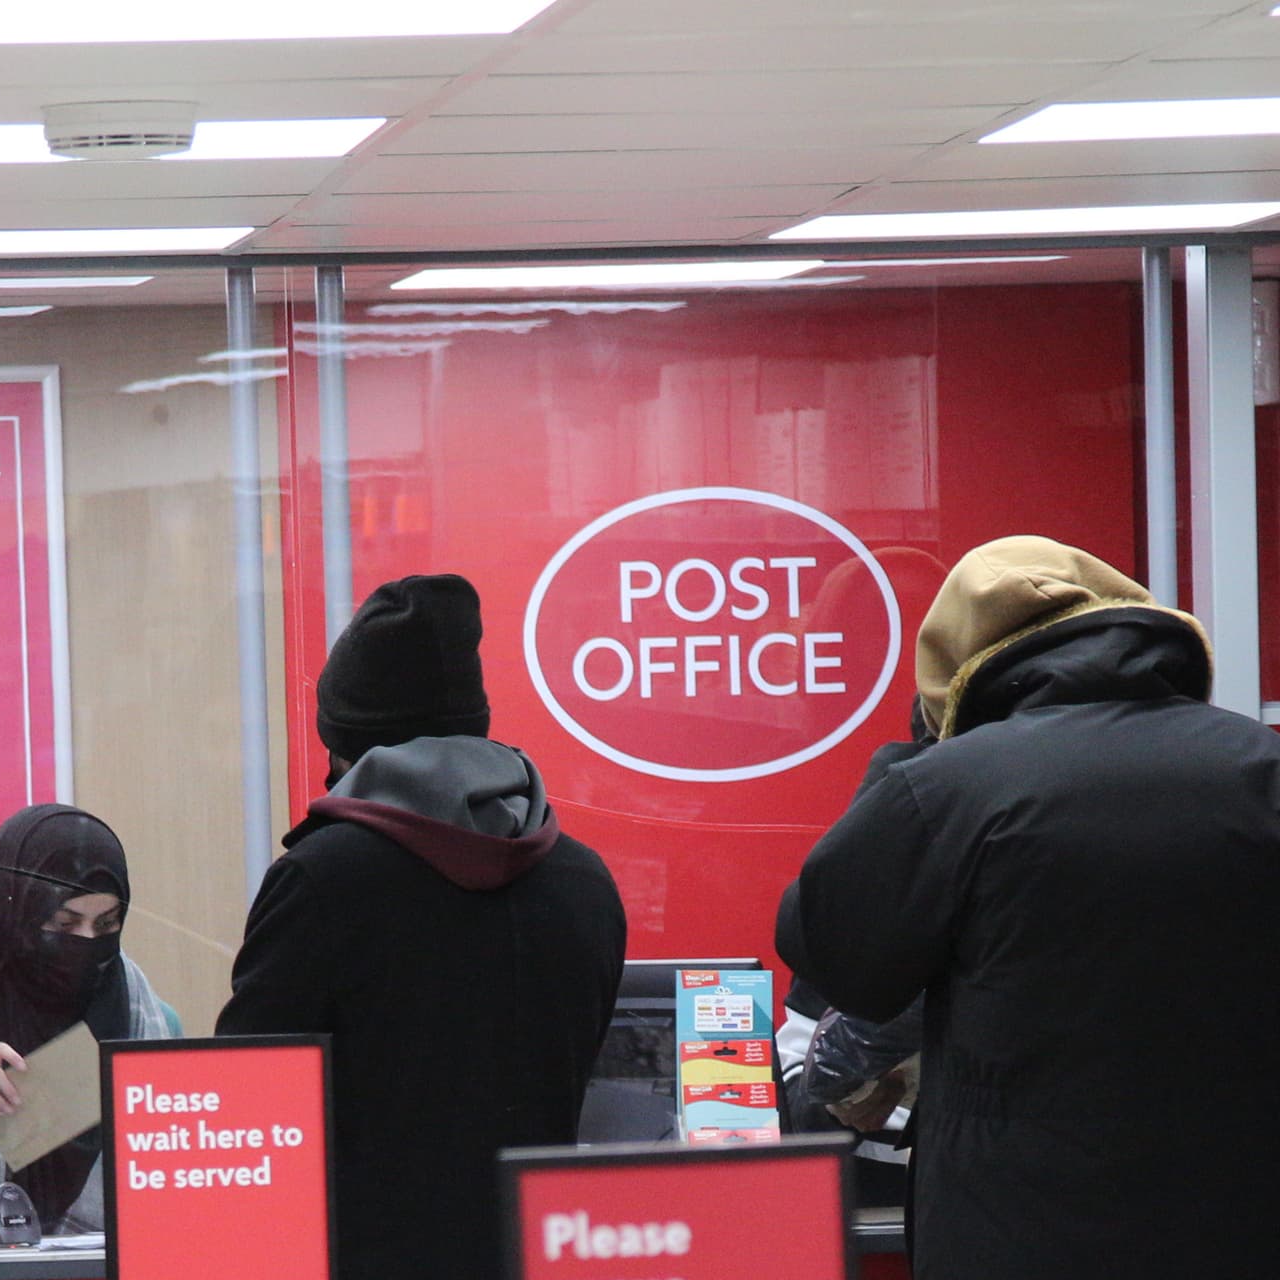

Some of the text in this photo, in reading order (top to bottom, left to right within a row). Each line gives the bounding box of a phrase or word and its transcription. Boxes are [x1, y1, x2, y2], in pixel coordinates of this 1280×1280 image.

[620, 557, 816, 623] POST
[572, 632, 846, 701] OFFICE
[125, 1084, 220, 1114] Please
[127, 1119, 303, 1152] wait here to
[128, 1155, 272, 1190] be served
[541, 1210, 692, 1262] Please
